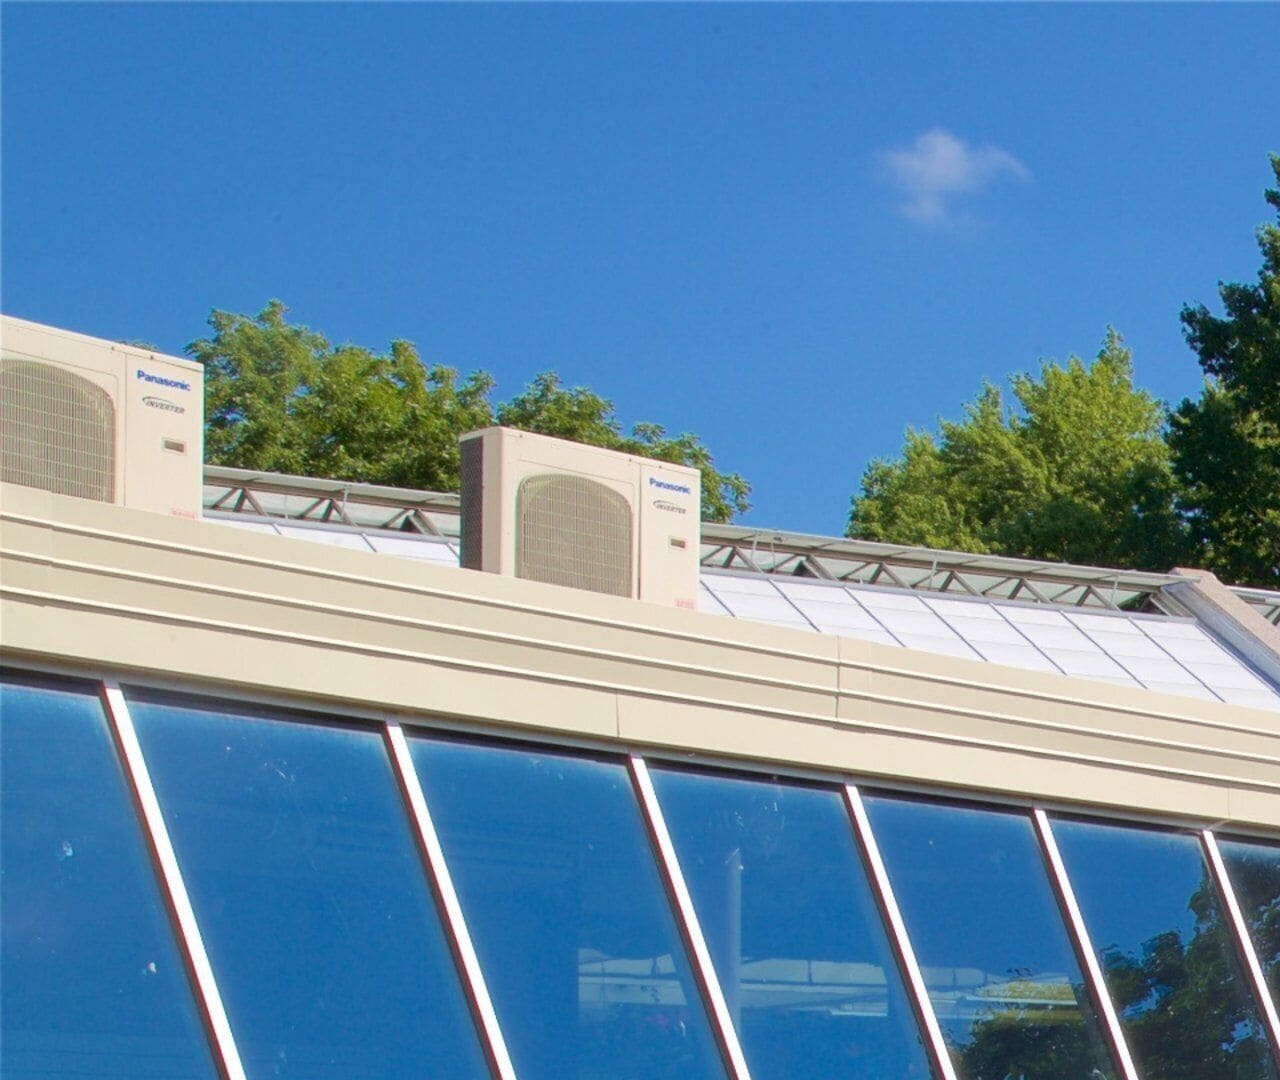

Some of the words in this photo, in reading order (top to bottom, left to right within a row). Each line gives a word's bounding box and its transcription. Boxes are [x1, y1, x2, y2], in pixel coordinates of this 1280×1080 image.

[137, 369, 191, 392] Panasonic
[146, 400, 185, 415] INVERTER
[649, 477, 691, 495] Panasonic
